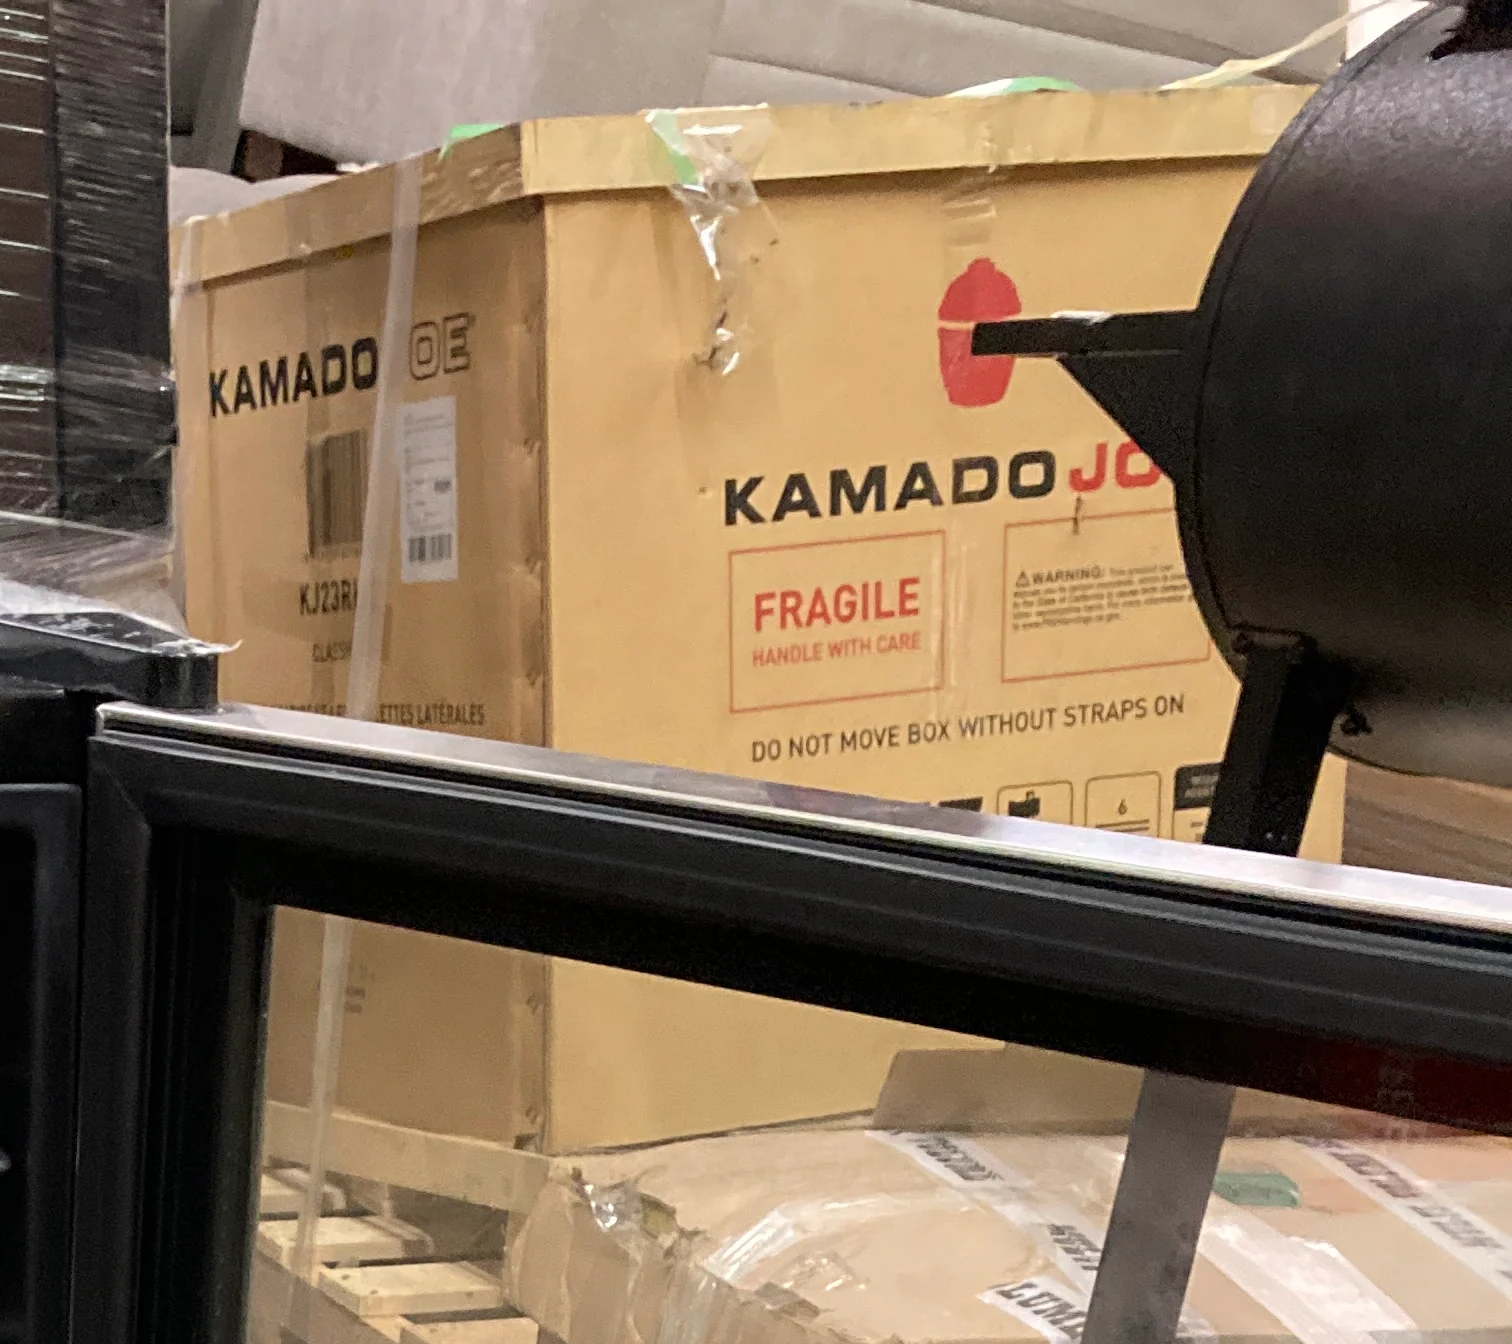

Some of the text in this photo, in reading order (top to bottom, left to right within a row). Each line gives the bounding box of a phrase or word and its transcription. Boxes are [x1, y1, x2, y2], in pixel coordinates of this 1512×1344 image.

[208, 312, 474, 417] KAMADO OE
[724, 438, 1162, 527] KAMADO JO
[753, 577, 921, 633] FRAGILE
[752, 631, 922, 667] HANDLE WITH CARE
[752, 693, 1185, 763] DO NOT MOVE BOX WITHOUT STRAPS ON
